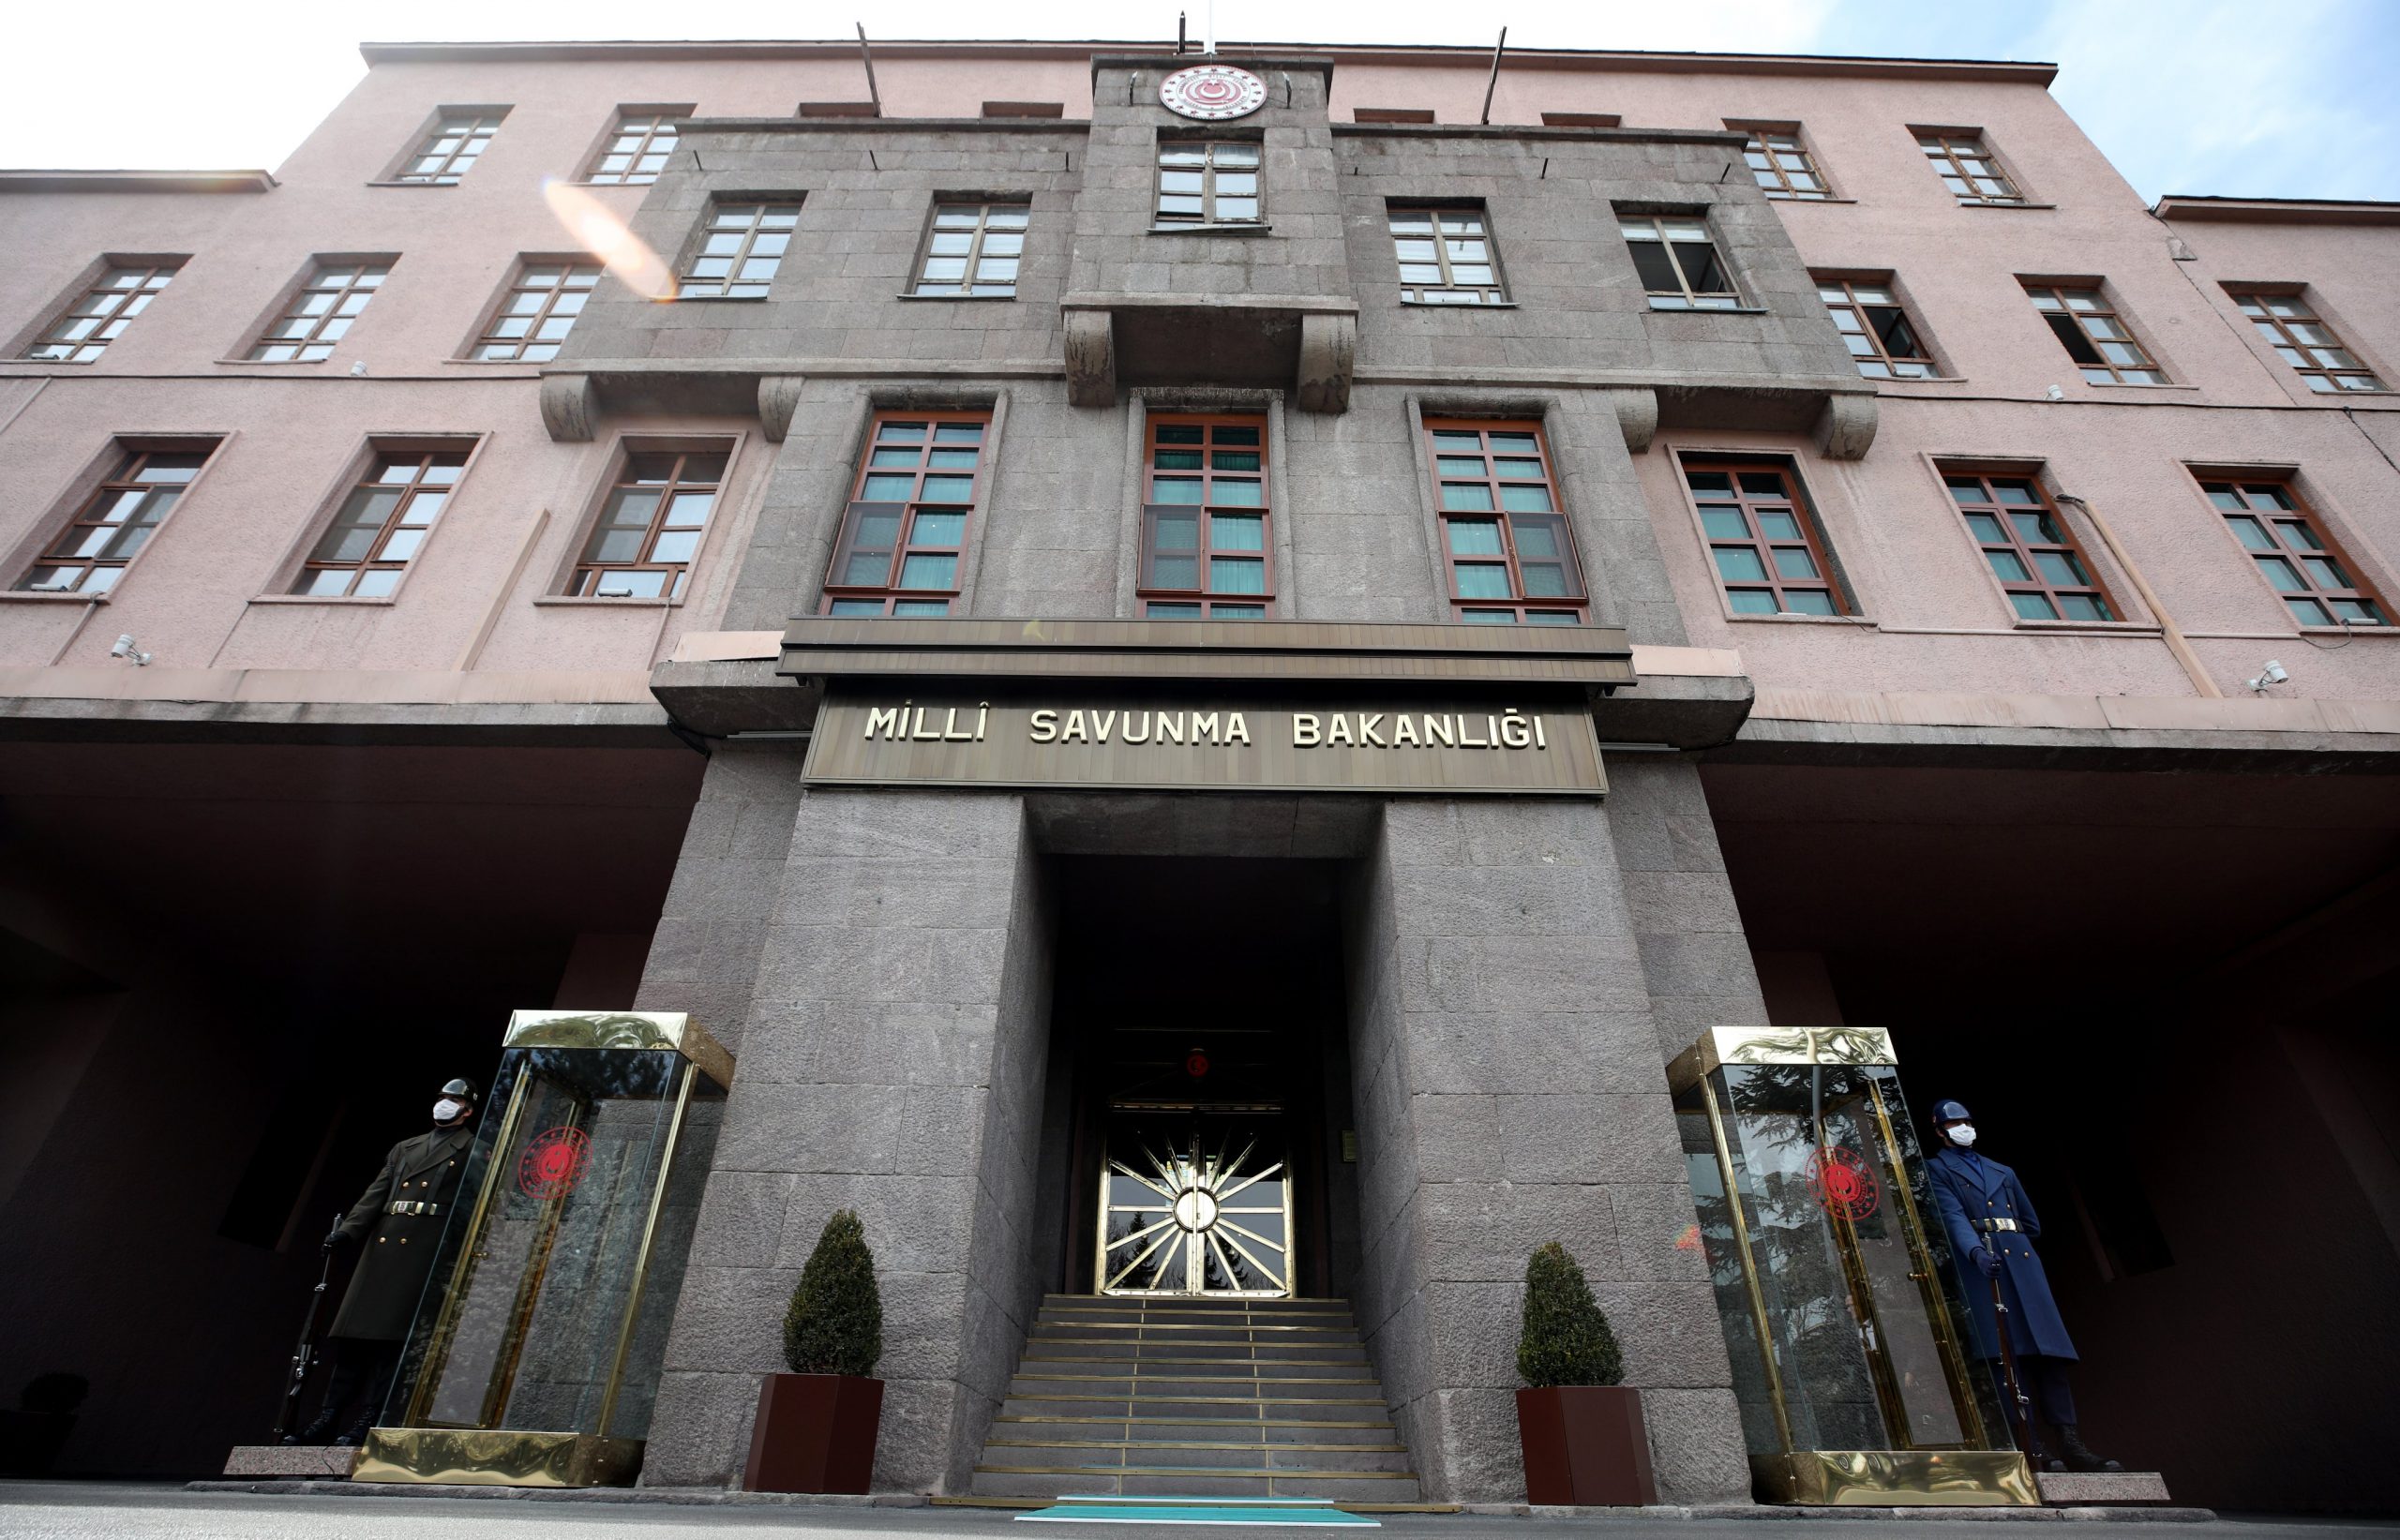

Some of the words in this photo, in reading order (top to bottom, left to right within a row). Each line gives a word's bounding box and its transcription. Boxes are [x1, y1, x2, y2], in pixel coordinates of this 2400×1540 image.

[864, 698, 990, 742] MİLLÎ
[1029, 710, 1251, 747] SAVUNMA
[1293, 708, 1546, 749] BAKANLIĞI
